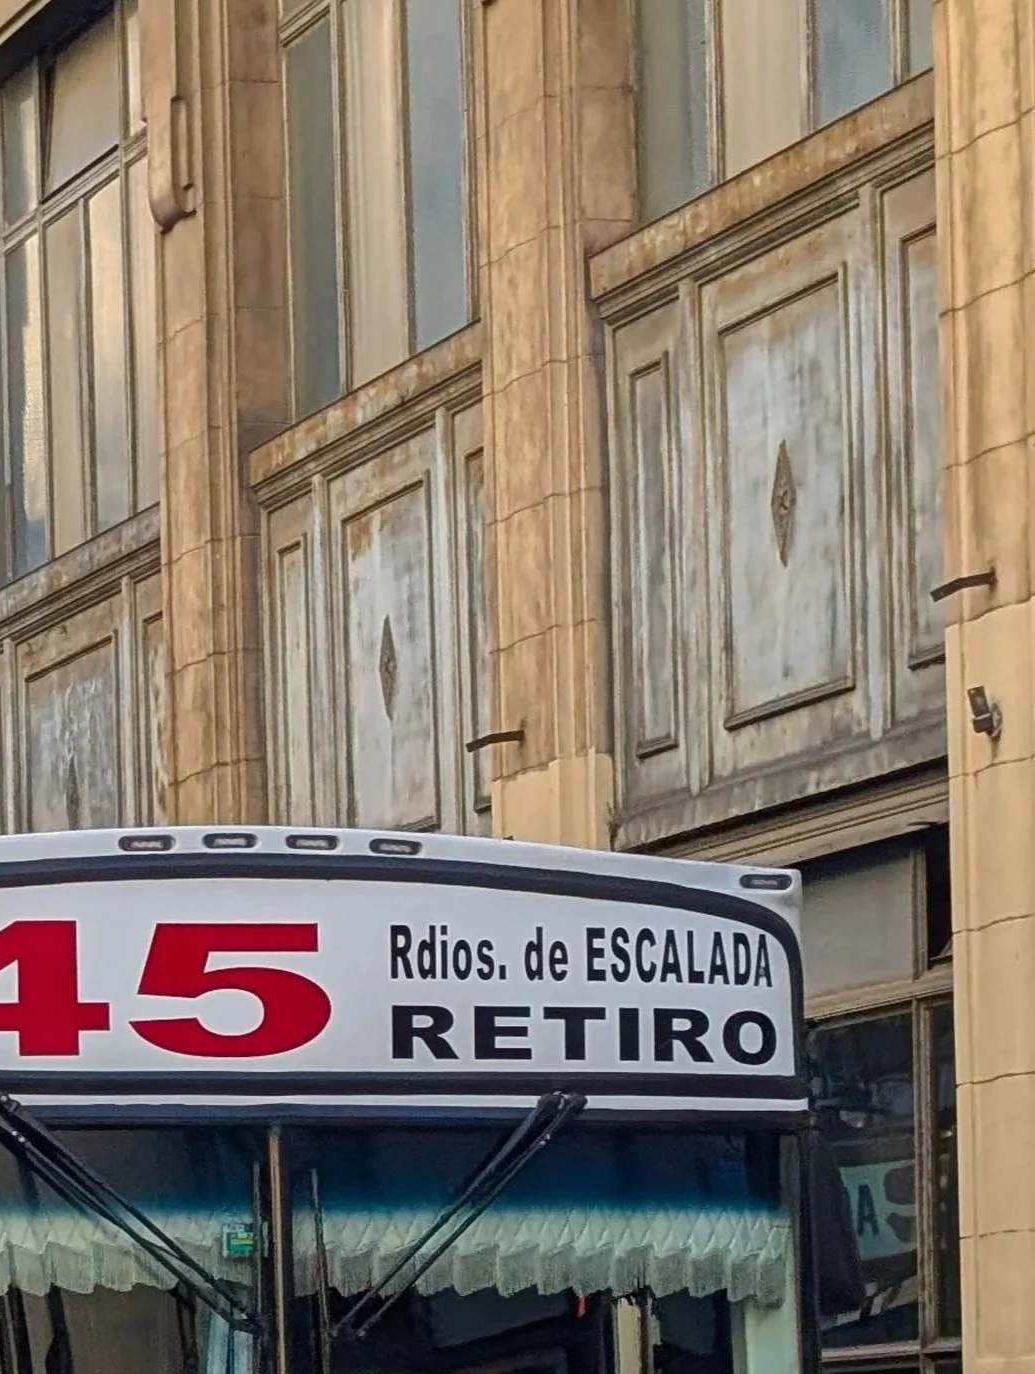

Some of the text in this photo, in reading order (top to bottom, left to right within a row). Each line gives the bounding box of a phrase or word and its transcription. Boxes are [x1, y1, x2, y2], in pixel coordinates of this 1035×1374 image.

[390, 924, 773, 988] Rdios. de ESCALADA
[391, 1005, 777, 1066] RETIRO
